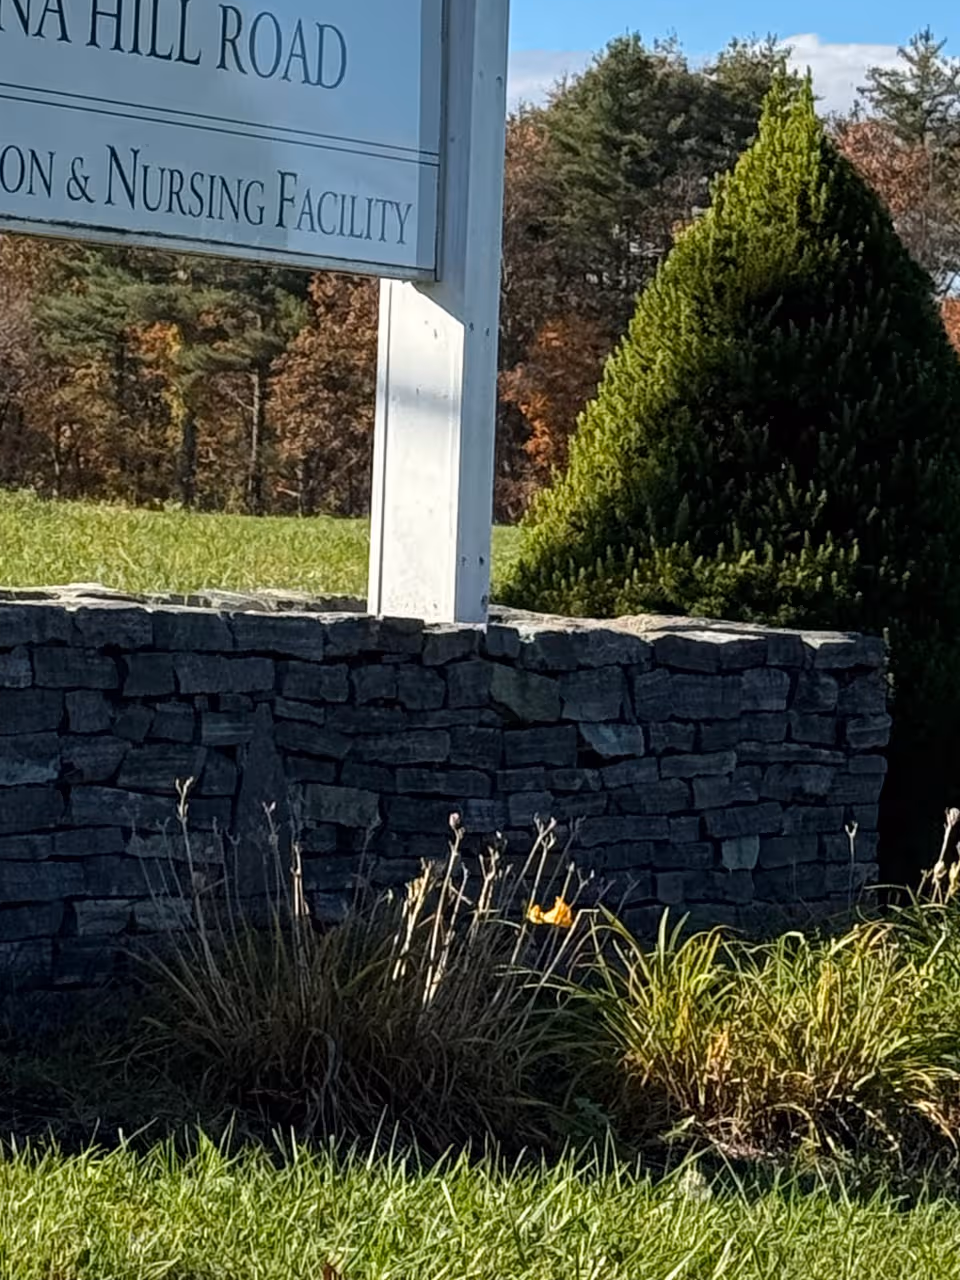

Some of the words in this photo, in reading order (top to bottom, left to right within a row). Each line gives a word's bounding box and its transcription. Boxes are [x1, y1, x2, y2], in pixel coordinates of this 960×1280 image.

[216, 3, 348, 89] ROAD
[66, 156, 94, 205] &
[104, 144, 266, 226] NURSING
[275, 169, 413, 246] FACILITY
